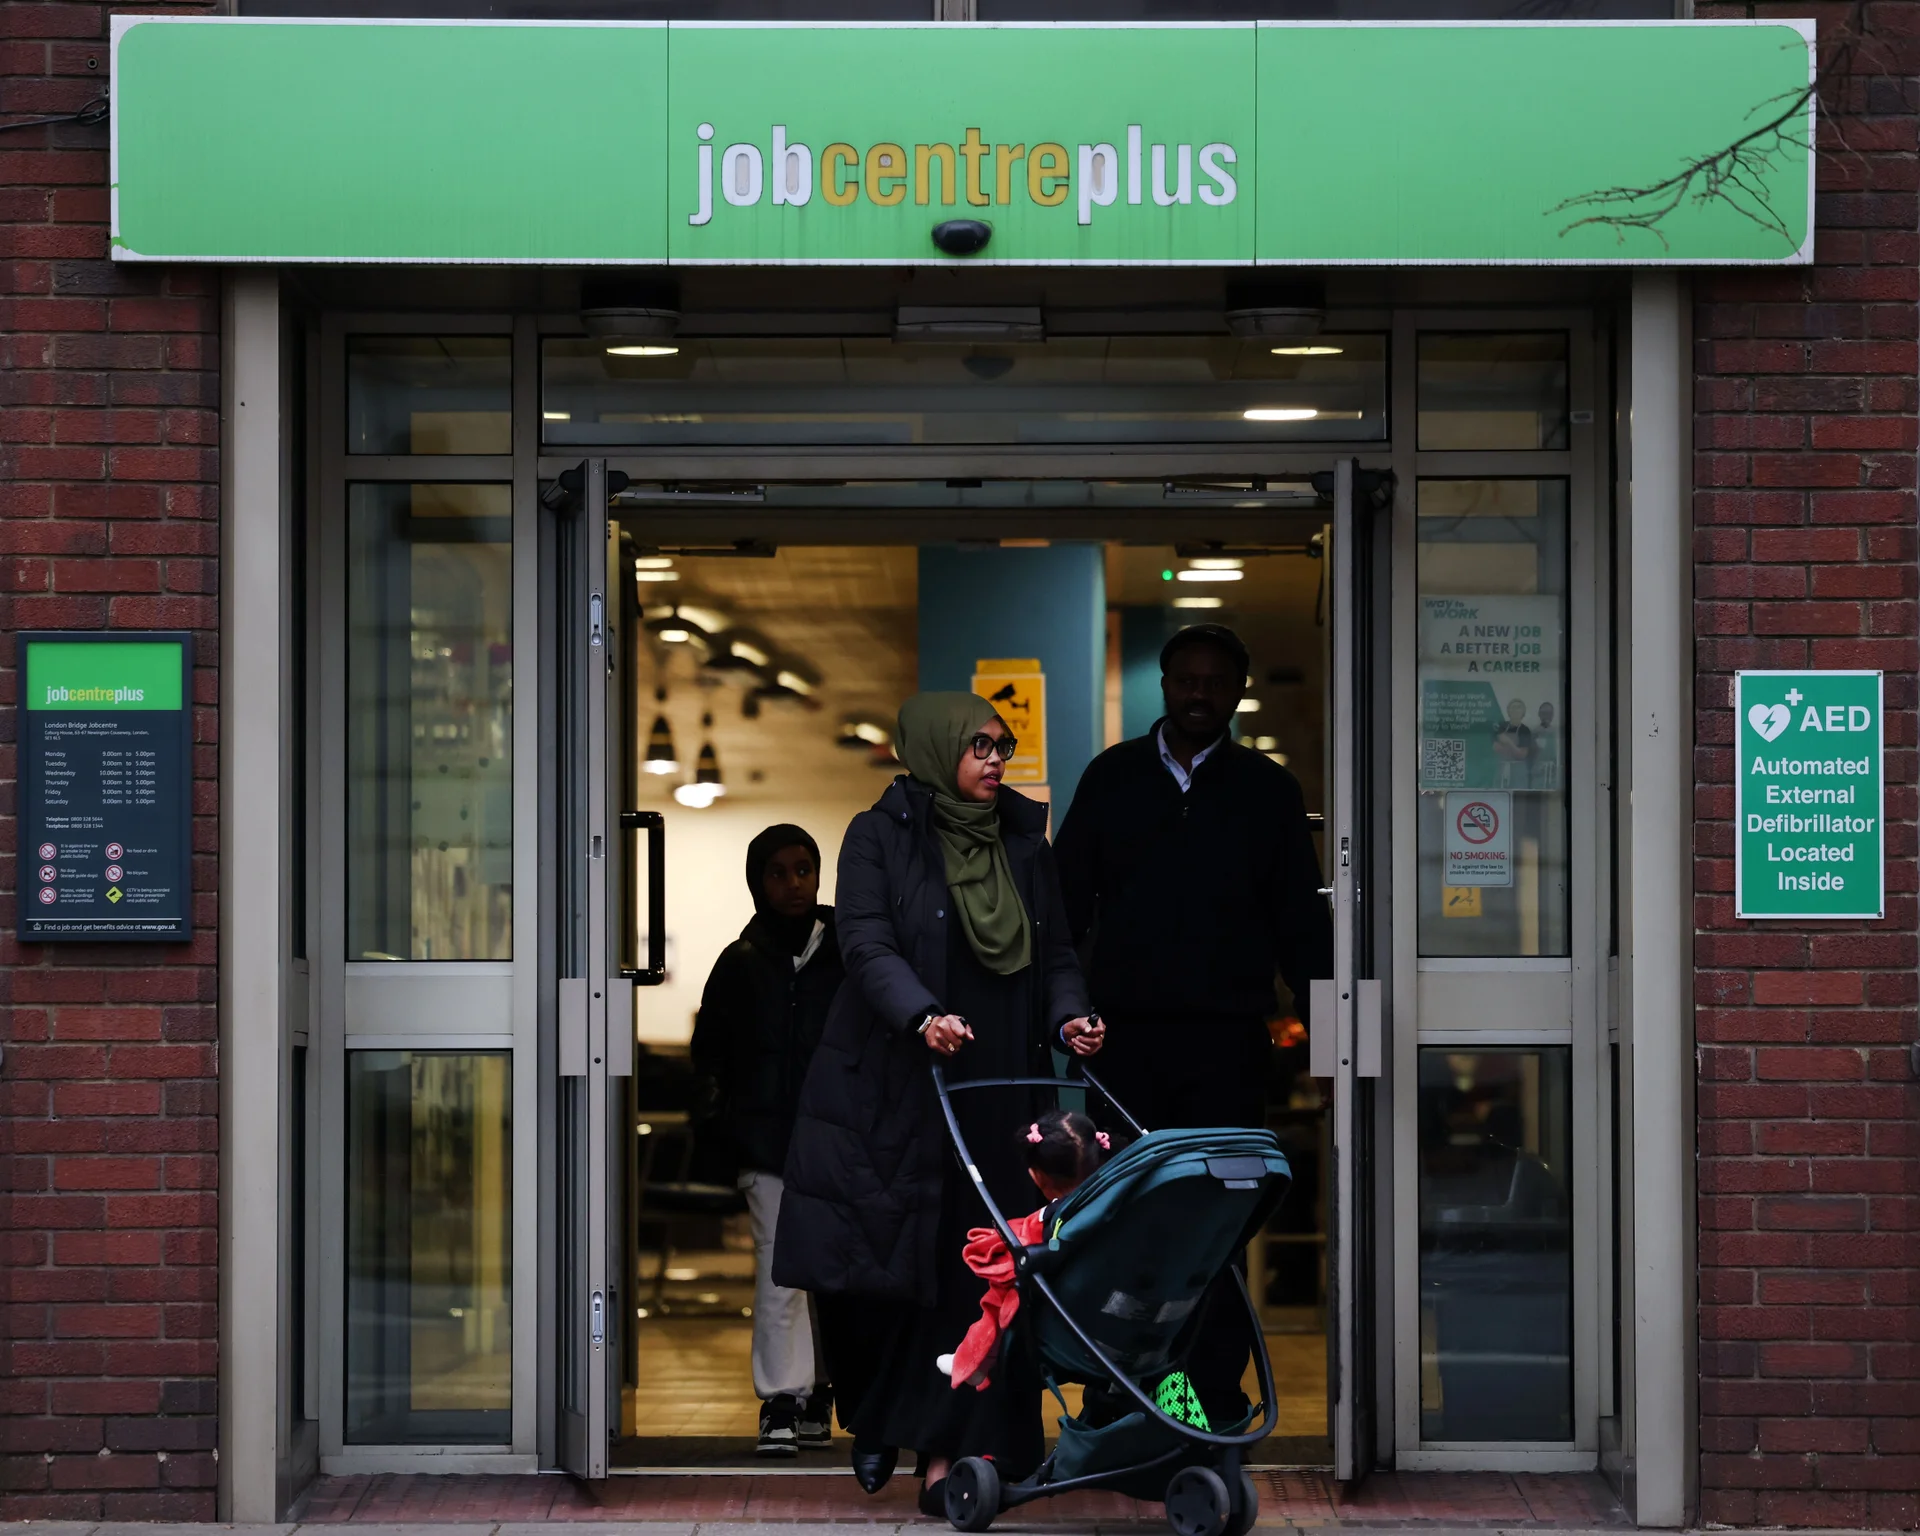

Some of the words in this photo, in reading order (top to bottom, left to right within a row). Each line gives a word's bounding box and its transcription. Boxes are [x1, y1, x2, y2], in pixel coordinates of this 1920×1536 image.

[688, 122, 1238, 225] jobcentreplus
[1425, 600, 1452, 612] way
[1433, 609, 1479, 620] WORK
[1458, 626, 1469, 637] A
[1474, 626, 1510, 637] NEW
[1513, 626, 1541, 640] JOB
[1440, 643, 1451, 654] A
[1456, 643, 1510, 654] BETTER
[1513, 643, 1541, 657] JOB
[1468, 661, 1478, 672] A
[1483, 661, 1540, 672] CAREER
[46, 686, 144, 704] jobcentreplus
[68, 722, 87, 730] Bridge
[1799, 706, 1871, 732] AED
[1751, 756, 1870, 775] Automated
[1766, 785, 1855, 804] External
[1747, 814, 1875, 833] Defibrillator
[1450, 852, 1463, 860] NO
[1767, 843, 1854, 862] Located
[1778, 872, 1844, 891] Inside
